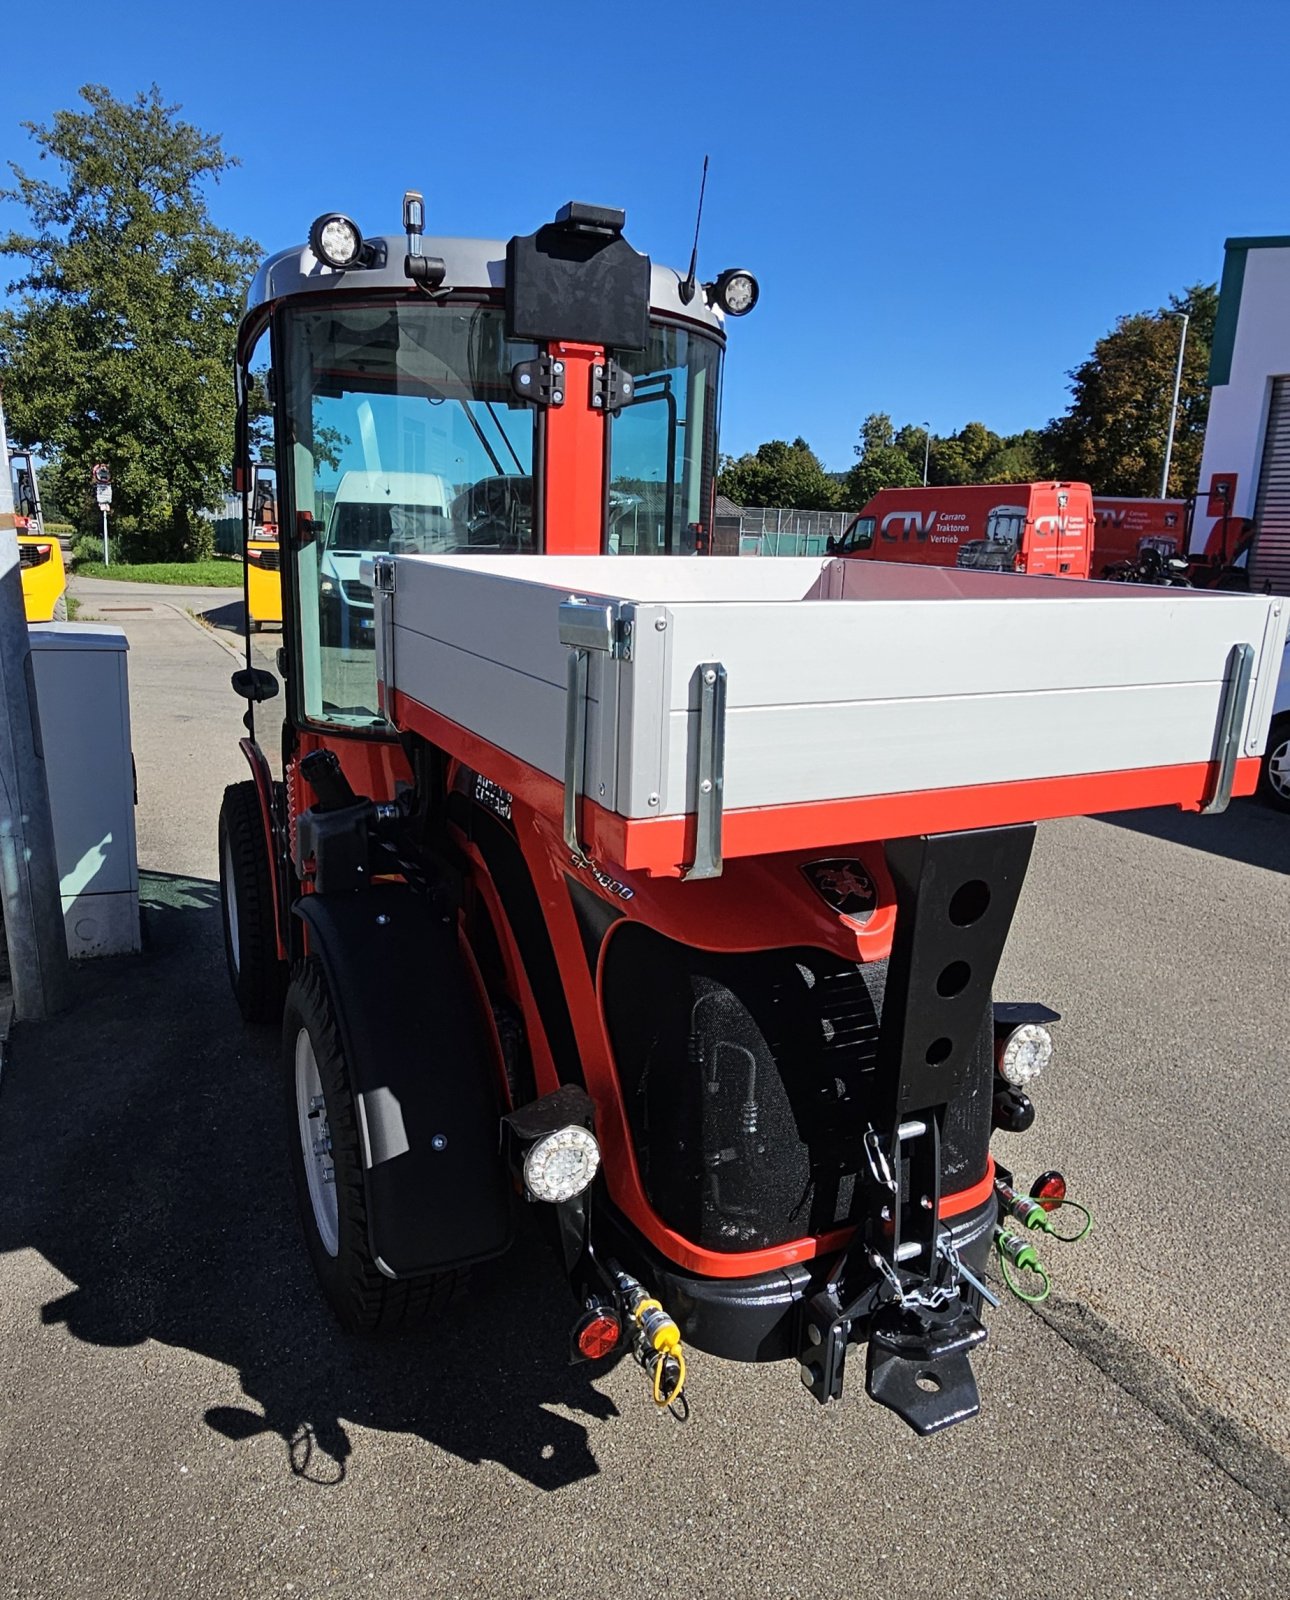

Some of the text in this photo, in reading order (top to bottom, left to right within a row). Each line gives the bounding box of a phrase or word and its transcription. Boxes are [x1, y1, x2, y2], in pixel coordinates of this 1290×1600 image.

[939, 513, 967, 521] Carraro
[1093, 508, 1127, 528] TV
[881, 511, 938, 543] CTV
[937, 523, 970, 532] Traktoren
[930, 535, 959, 543] Vertrieb
